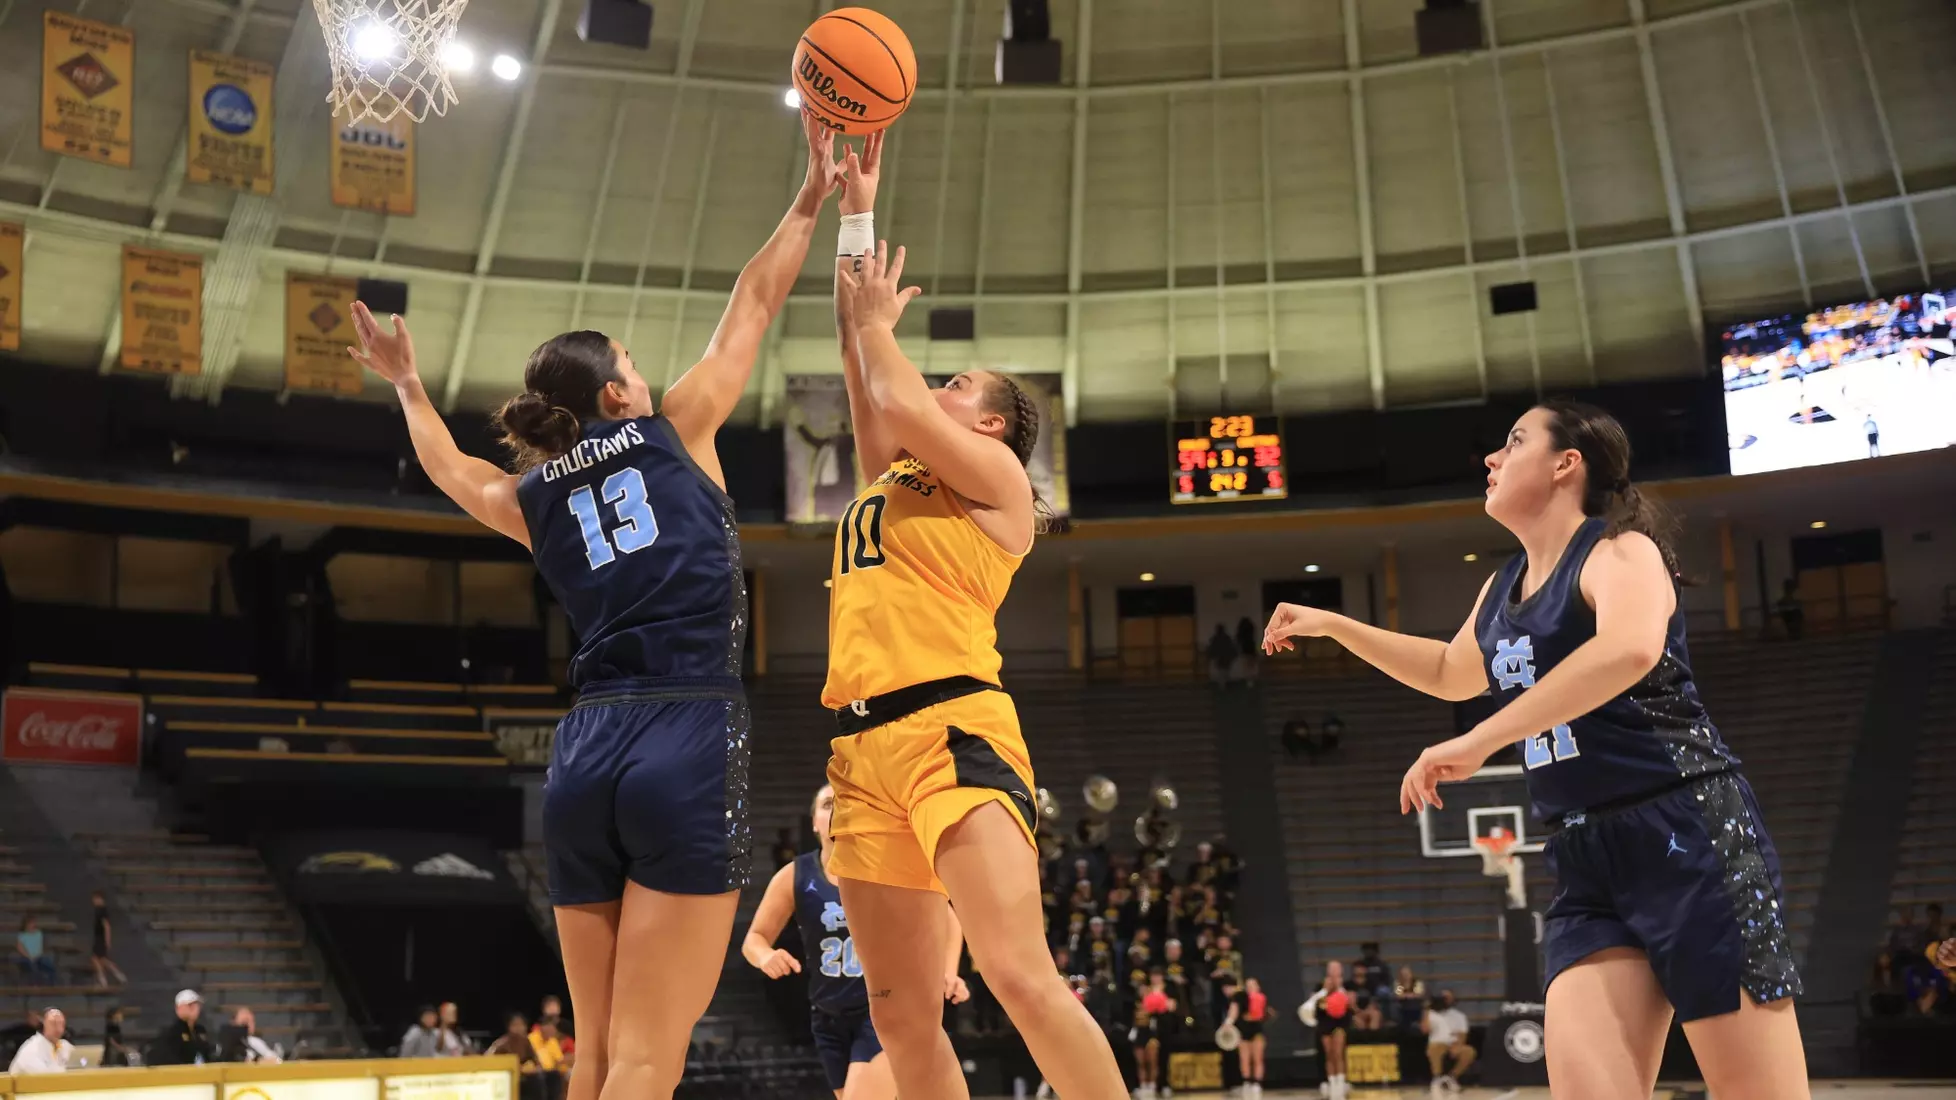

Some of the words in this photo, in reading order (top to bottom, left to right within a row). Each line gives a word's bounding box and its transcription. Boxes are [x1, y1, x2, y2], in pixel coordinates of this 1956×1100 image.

[800, 50, 867, 116] Wilson
[1210, 415, 1254, 438] 2:23
[894, 473, 937, 498] MISS
[567, 466, 660, 571] 13
[840, 493, 886, 577] 10
[819, 936, 864, 977] 20
